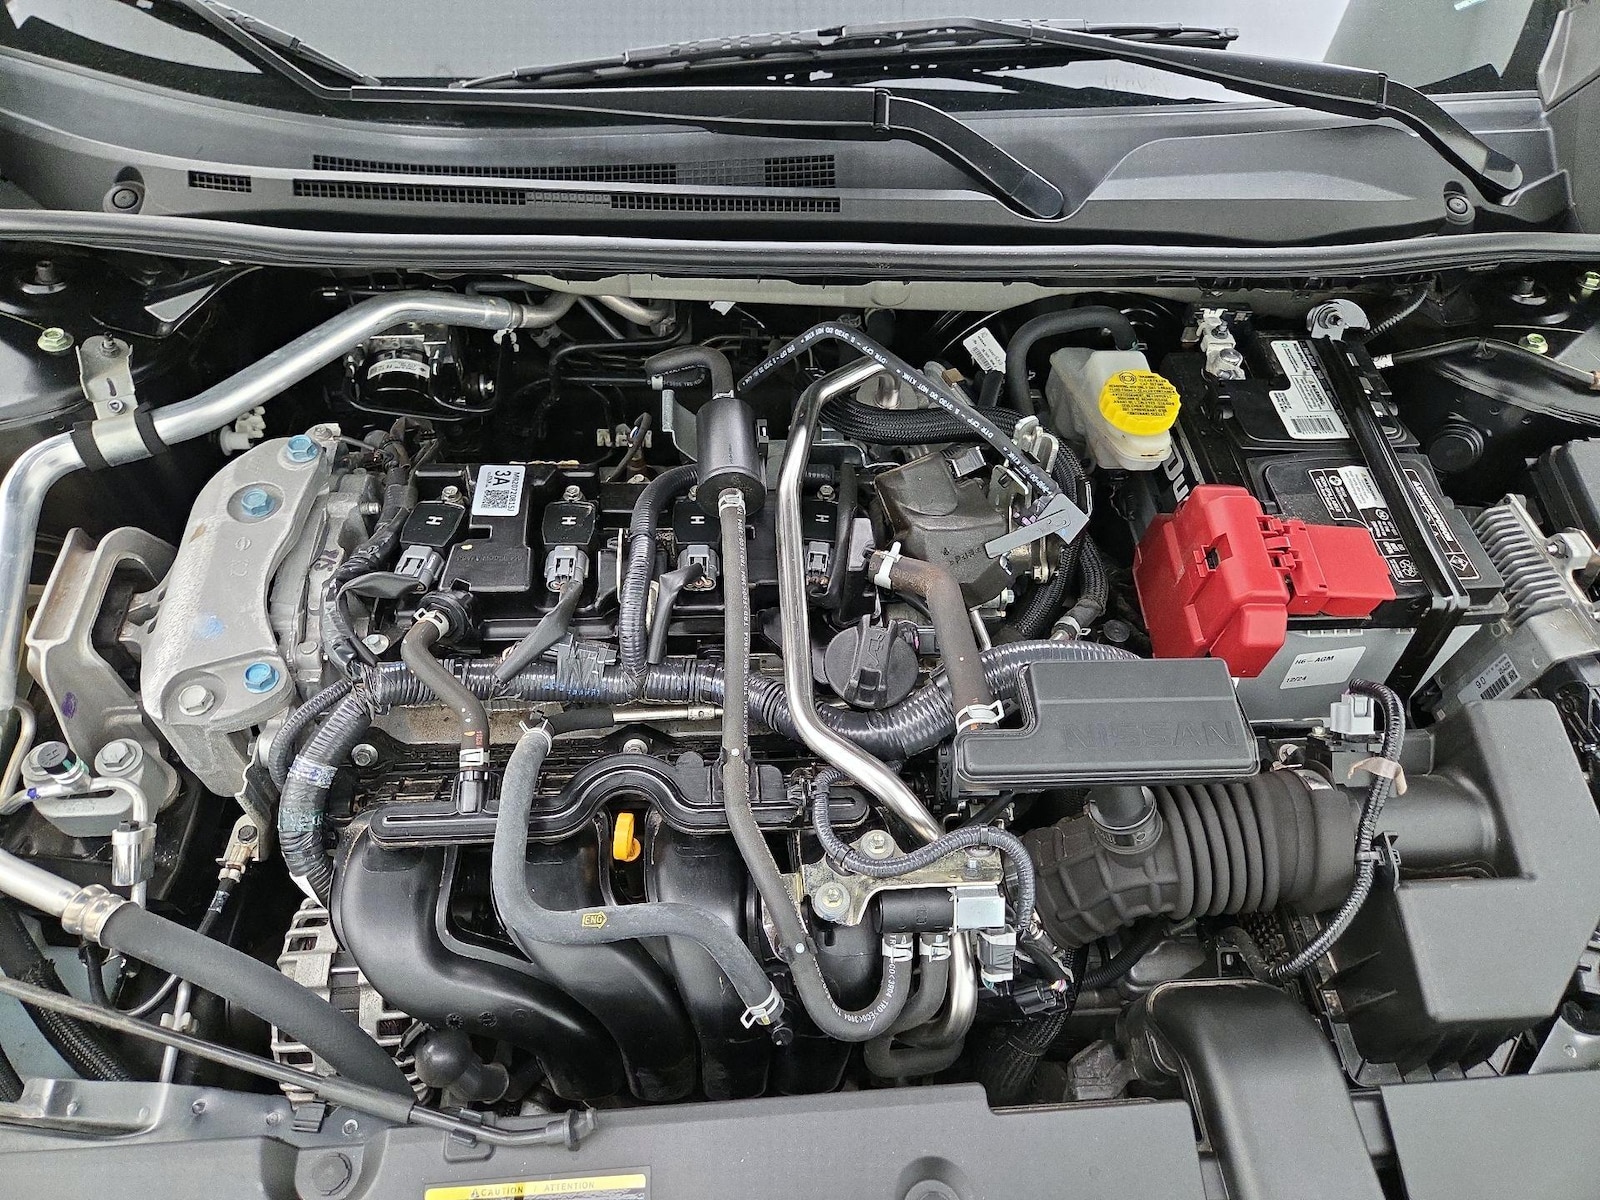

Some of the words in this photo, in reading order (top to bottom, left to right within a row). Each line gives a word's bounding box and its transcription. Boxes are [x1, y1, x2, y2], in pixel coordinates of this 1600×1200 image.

[493, 470, 512, 486] 3A
[1063, 720, 1240, 750] NISSAN
[585, 914, 602, 925] ENG
[481, 1186, 524, 1198] CAUTION
[544, 1181, 596, 1192] ATTENTION
